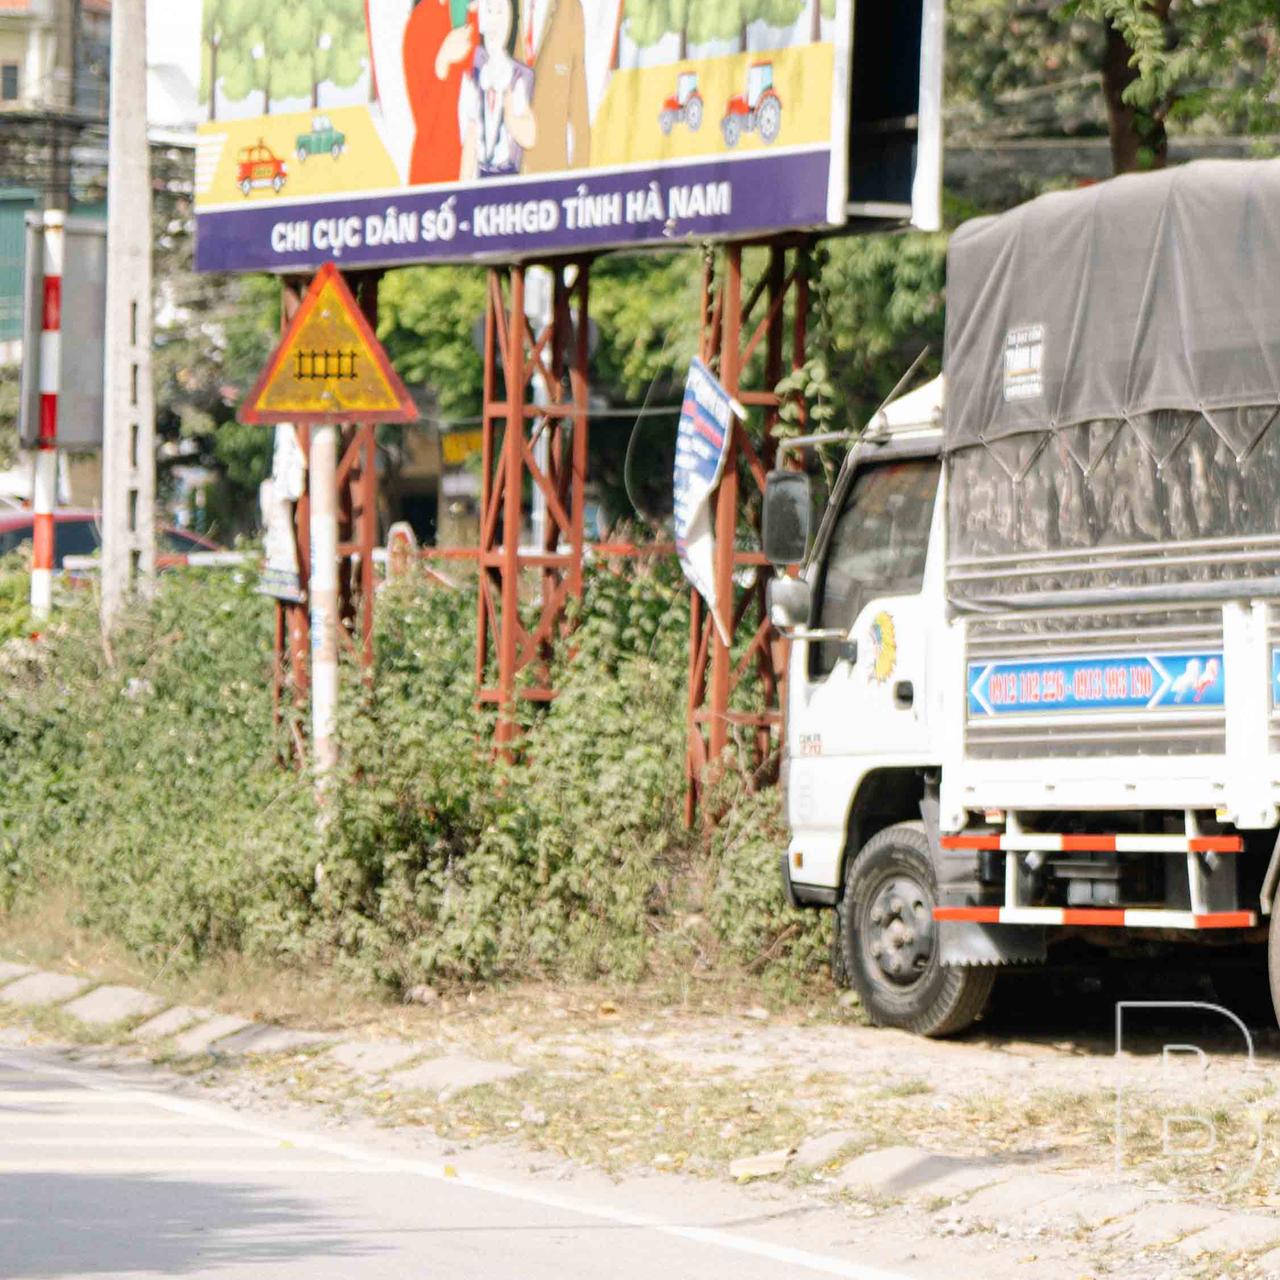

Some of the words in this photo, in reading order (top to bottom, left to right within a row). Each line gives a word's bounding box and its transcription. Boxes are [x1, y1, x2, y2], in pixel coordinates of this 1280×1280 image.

[271, 220, 310, 252] CHI
[314, 216, 362, 257] CỤC
[365, 206, 418, 246] DÂN
[422, 195, 456, 242] SỐ
[562, 184, 622, 230] TỈNH
[626, 181, 664, 224] HÀ
[668, 182, 732, 219] NAM
